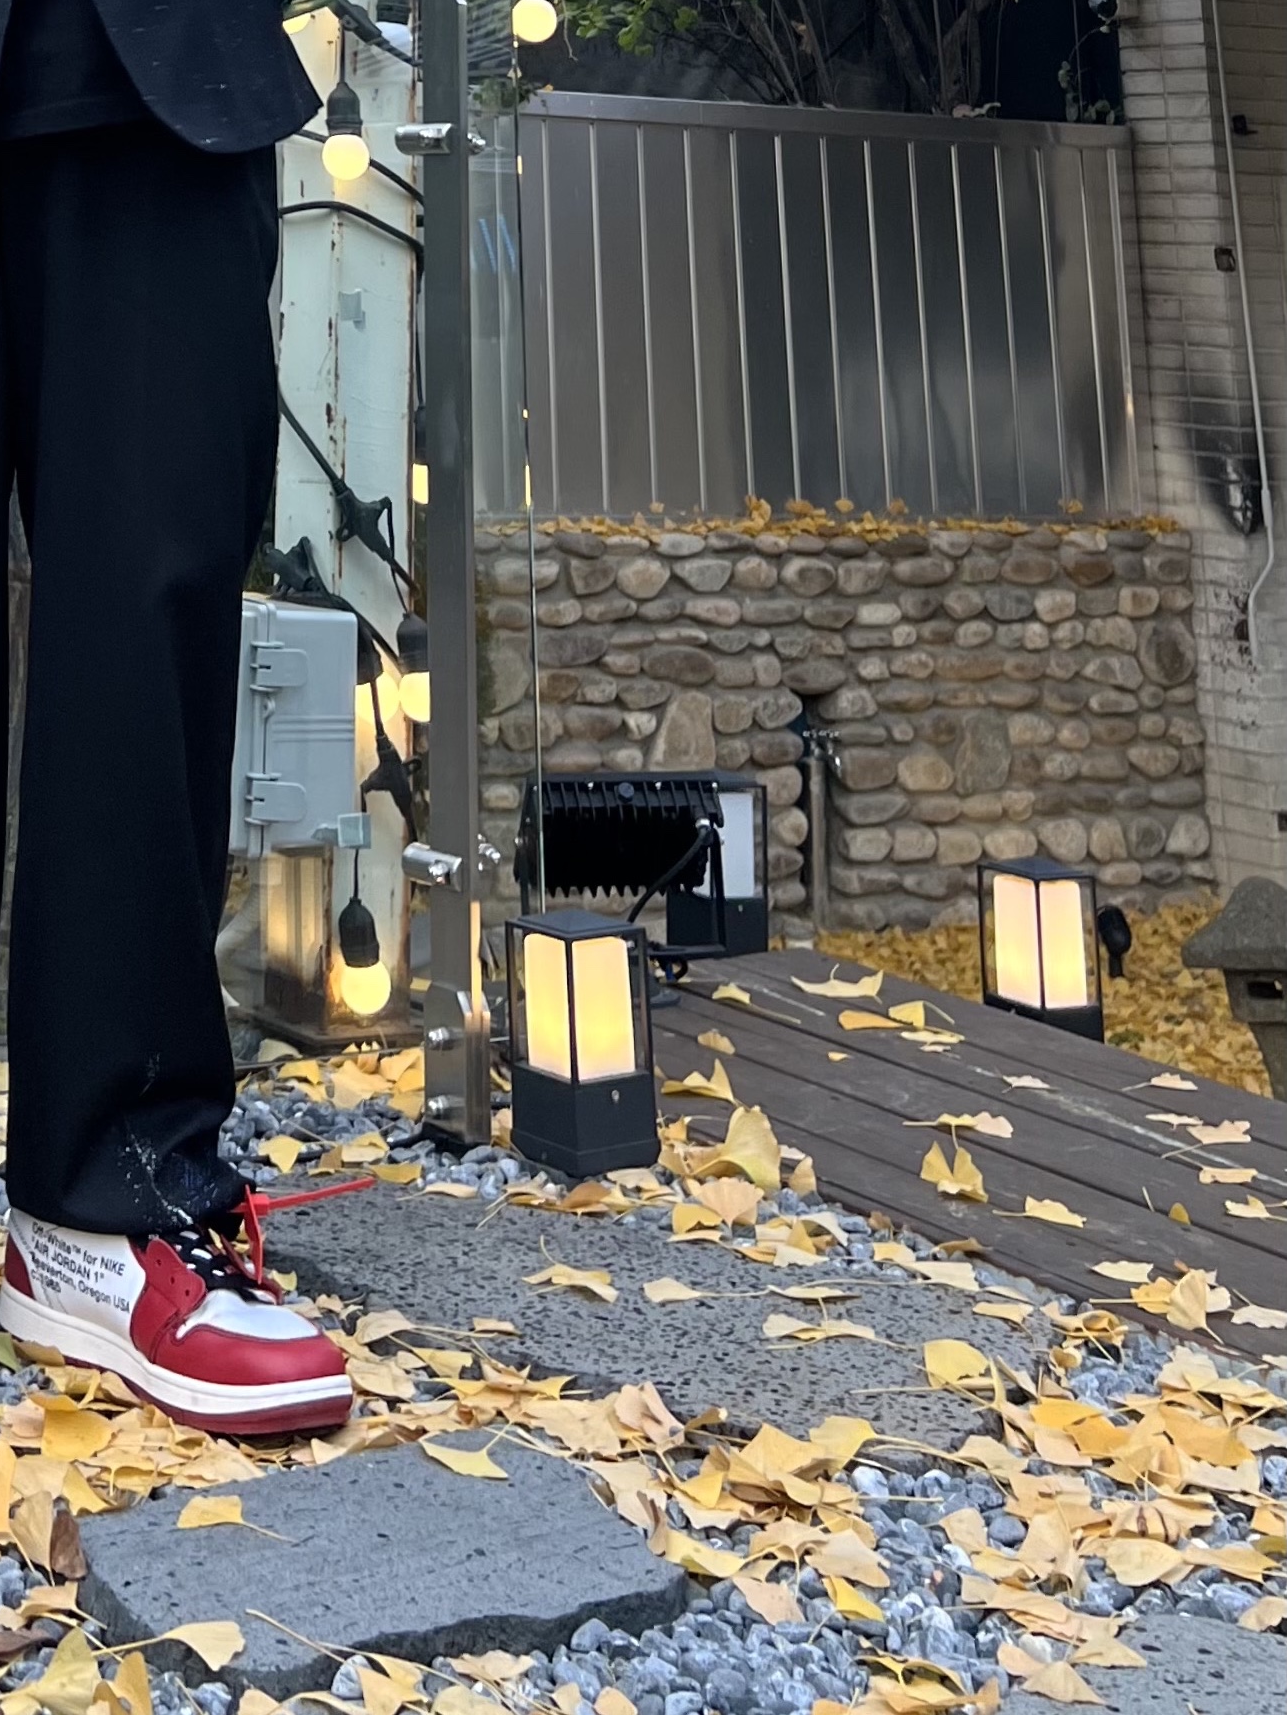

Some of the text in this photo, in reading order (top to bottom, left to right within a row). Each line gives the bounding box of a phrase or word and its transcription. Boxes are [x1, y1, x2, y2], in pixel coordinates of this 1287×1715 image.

[51, 1250, 91, 1281] JORDAN
[83, 1250, 98, 1265] for
[100, 1256, 126, 1277] NIKE
[78, 1280, 112, 1304] Oregon
[113, 1294, 130, 1314] USA
